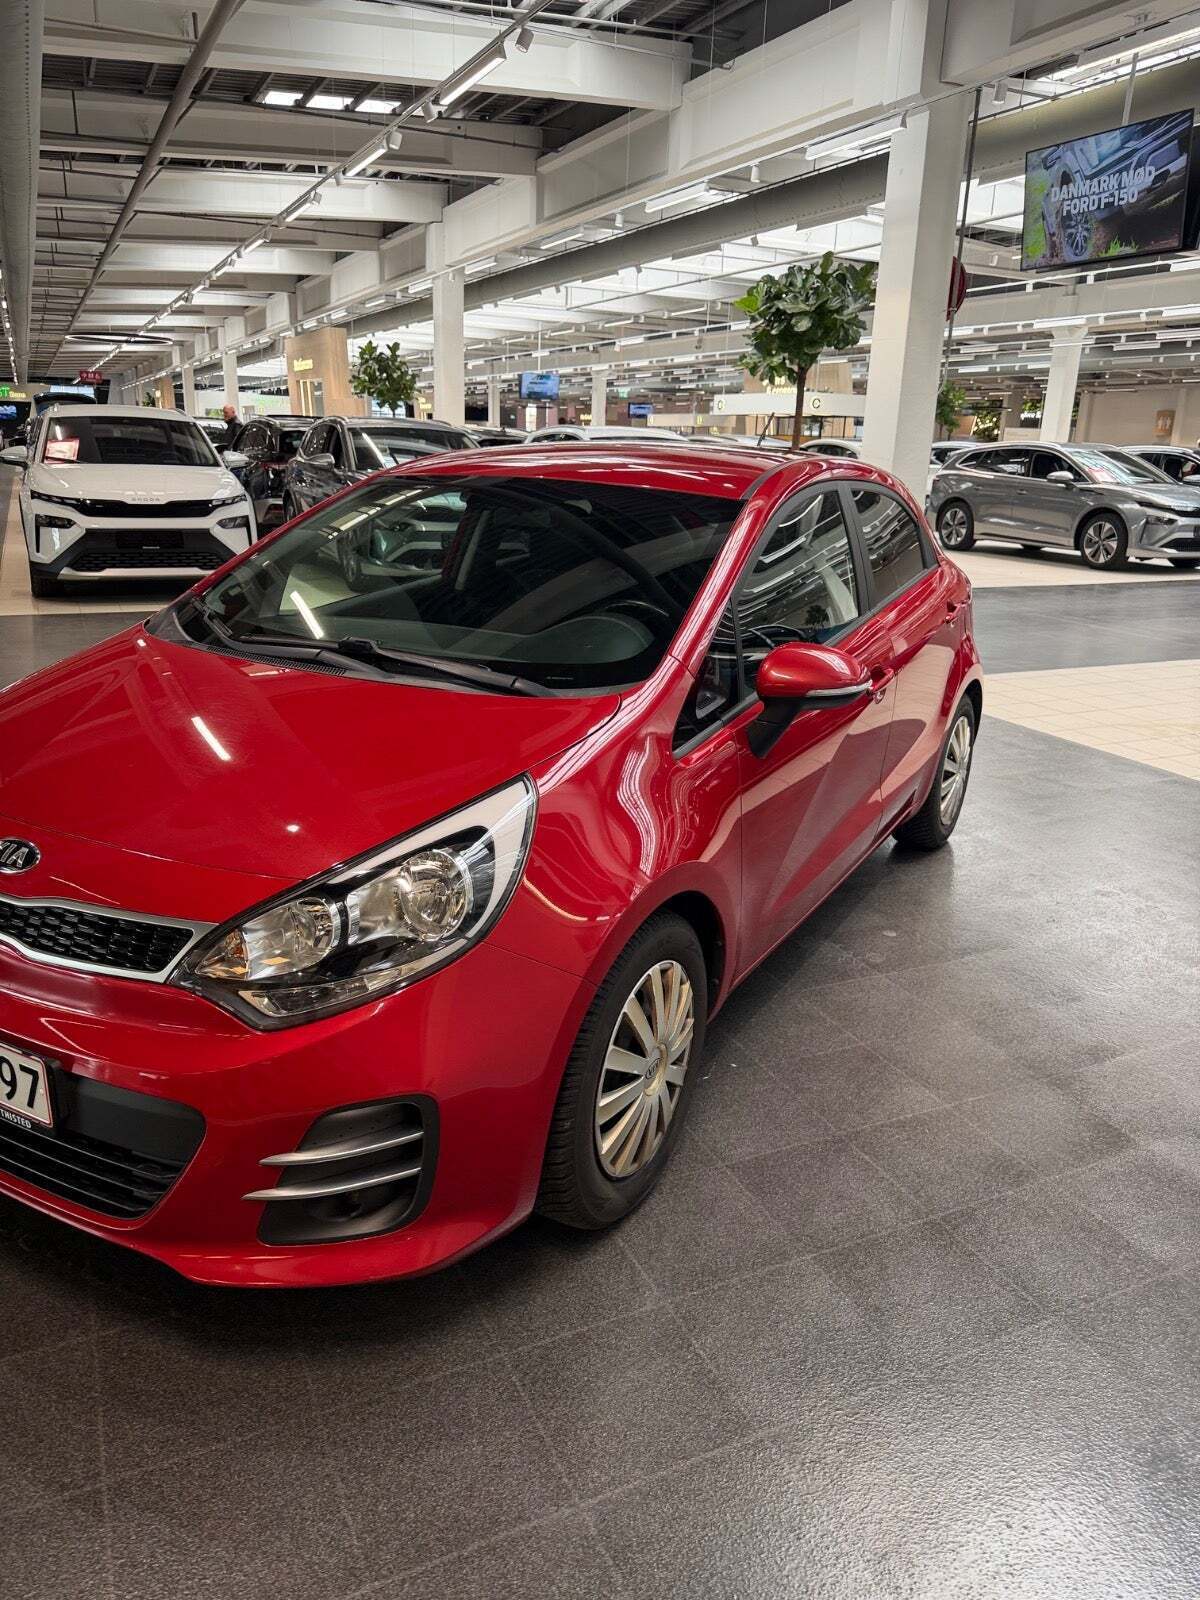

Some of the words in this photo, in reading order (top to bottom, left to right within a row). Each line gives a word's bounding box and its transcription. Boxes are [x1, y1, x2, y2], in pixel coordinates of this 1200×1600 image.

[1051, 172, 1119, 201] DANMARK
[1063, 194, 1099, 216] FORD
[1101, 189, 1138, 208] F-150
[0, 1055, 40, 1109] 97
[0, 1109, 32, 1129] THISTED
